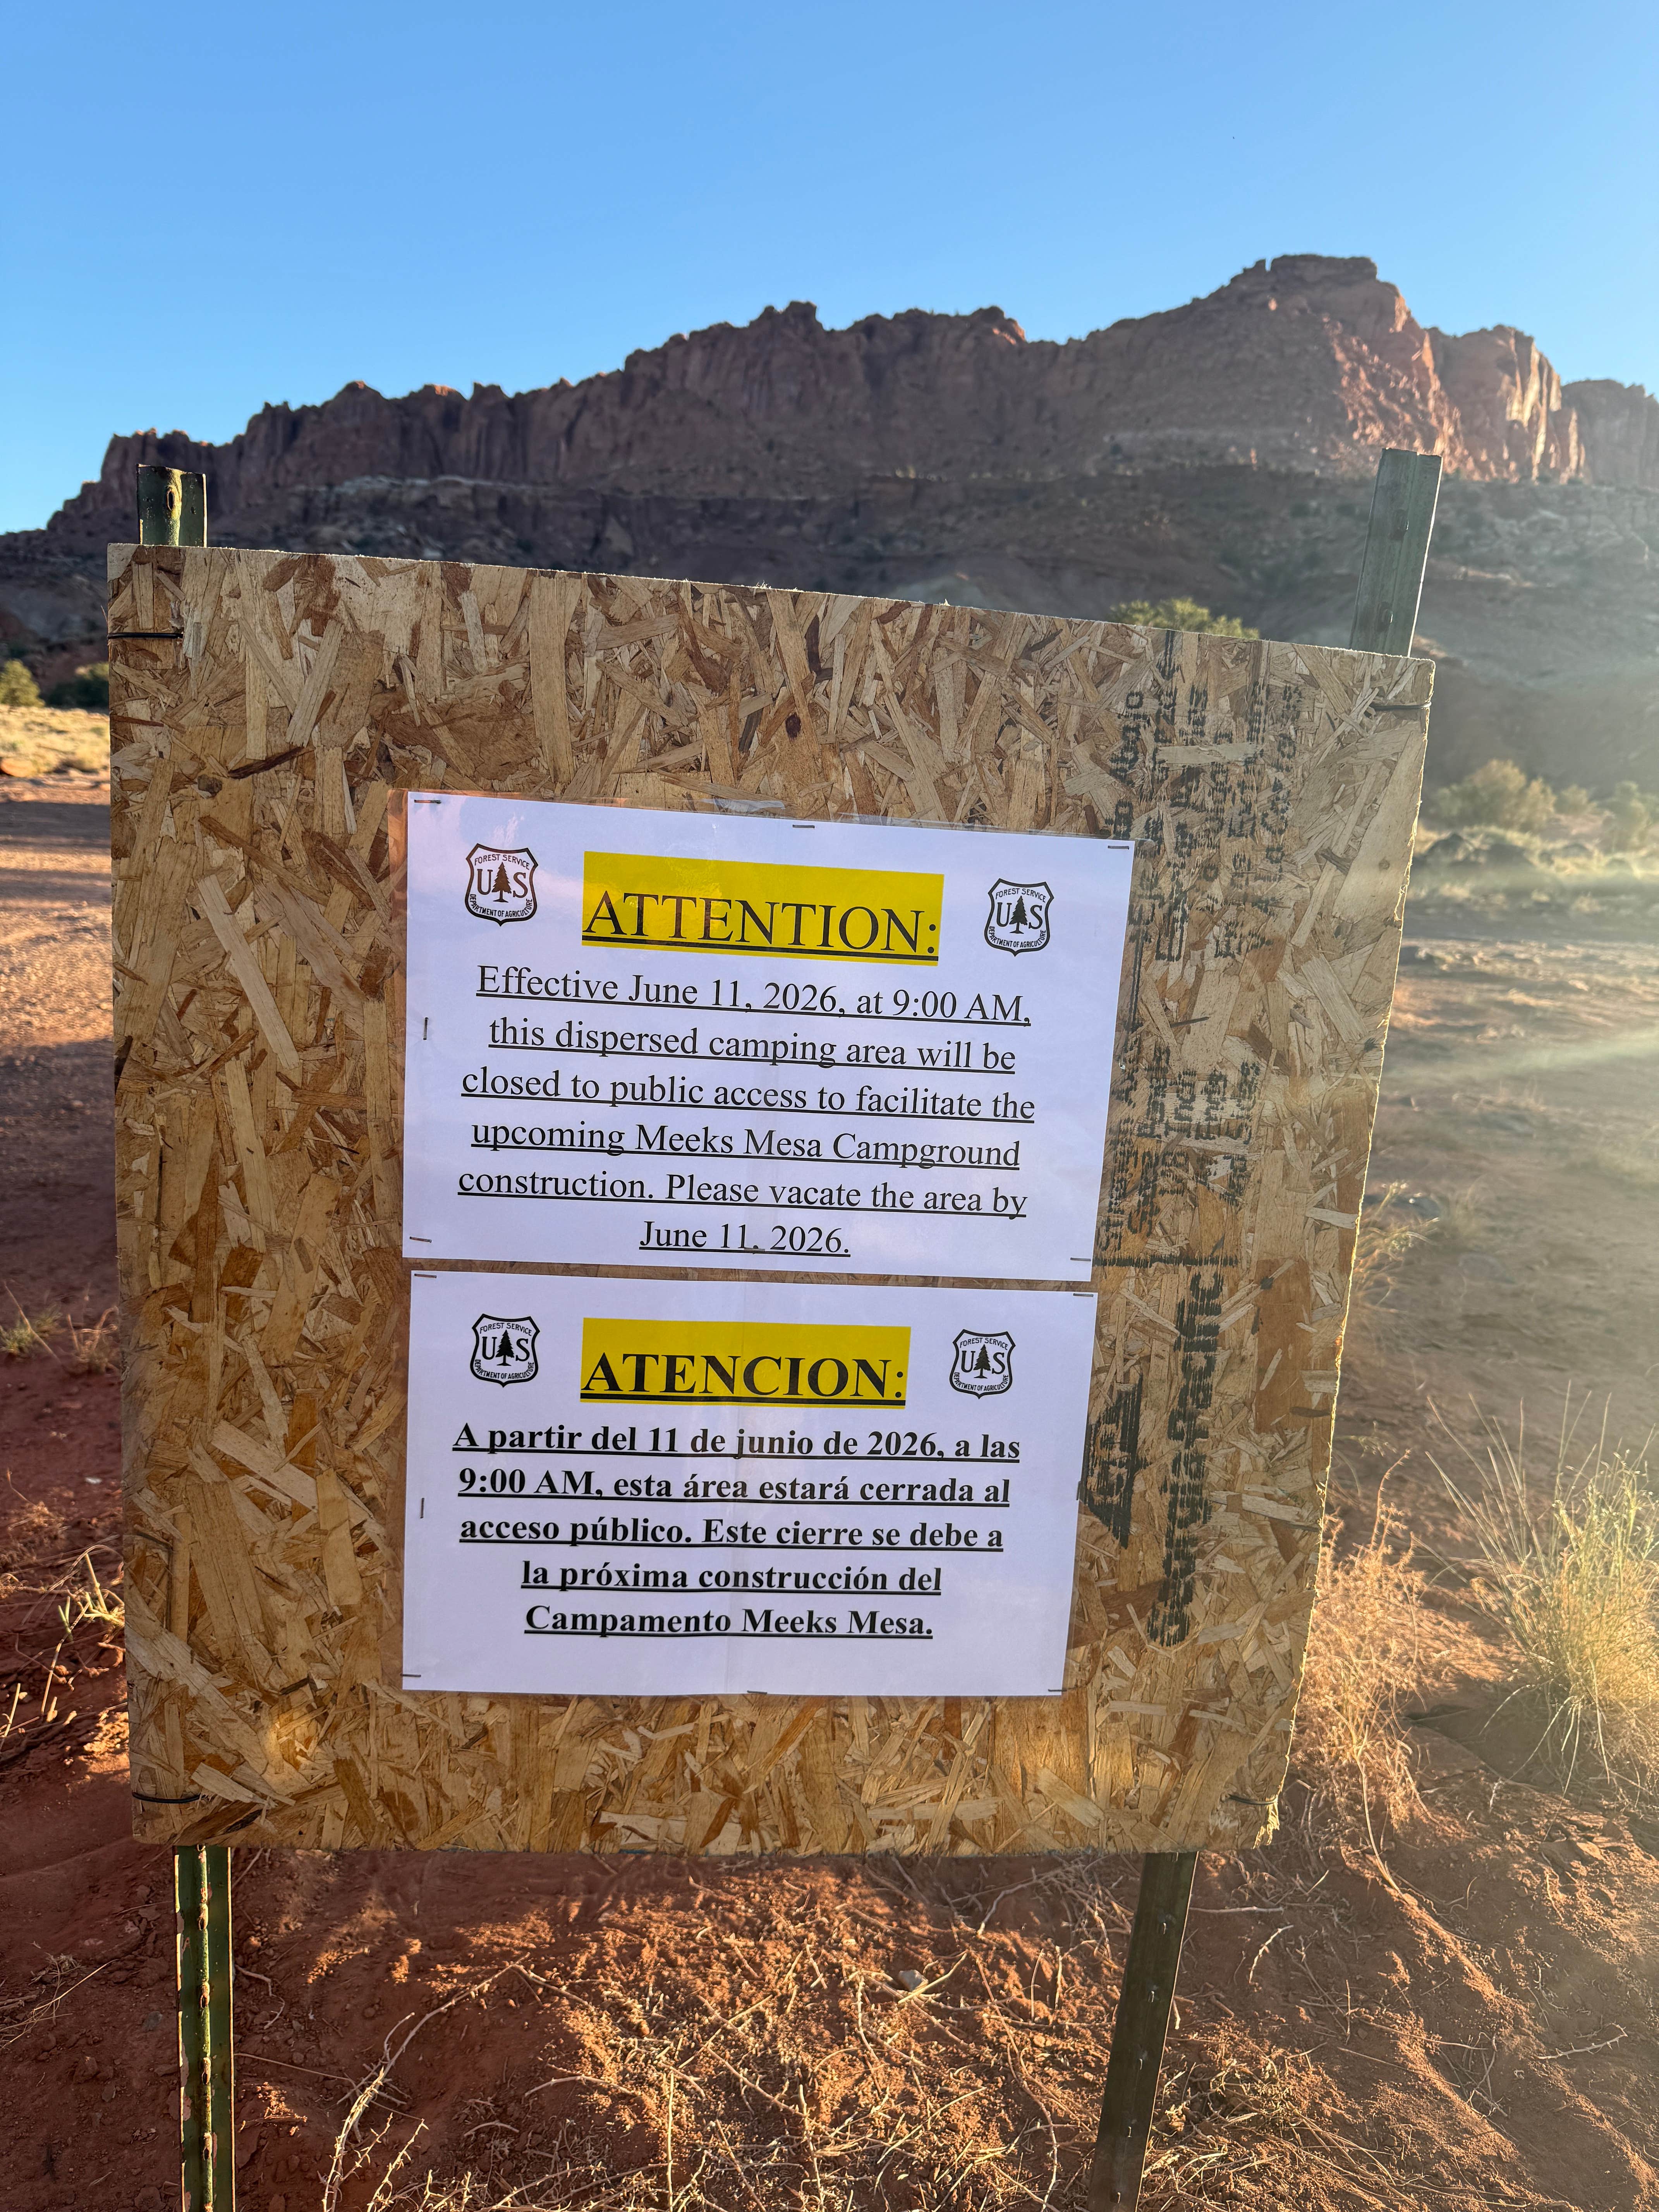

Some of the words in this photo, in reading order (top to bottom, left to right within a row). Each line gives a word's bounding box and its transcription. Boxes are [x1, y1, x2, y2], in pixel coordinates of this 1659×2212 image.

[474, 854, 500, 866] FOREST
[502, 855, 529, 870] SERVICE
[470, 894, 497, 916] DEPARTMENT
[505, 898, 532, 917] AGRICULTURE
[996, 888, 1020, 899] FOREST
[1022, 888, 1046, 902] SERVICE
[582, 891, 936, 953] ATTENTION:
[989, 926, 1013, 947] DEPARTMENT
[1020, 930, 1046, 948] AGRICULTURE
[477, 965, 618, 1000] Effective
[629, 975, 697, 1004] June
[712, 980, 751, 1012] 11,
[763, 983, 845, 1017] 2026,
[857, 992, 883, 1014] at
[893, 990, 957, 1018] 9:00
[964, 993, 1030, 1026] AM,
[489, 1017, 544, 1046] this
[556, 1021, 698, 1057] dispersed
[709, 1033, 836, 1068] camping
[847, 1045, 906, 1064] area
[917, 1041, 970, 1067] will
[984, 1042, 1015, 1070] be
[463, 1066, 560, 1096] closed
[571, 1075, 599, 1098] to
[610, 1075, 703, 1107] public
[714, 1087, 806, 1108] access
[818, 1087, 844, 1110] to
[855, 1085, 981, 1116] facilitate
[993, 1092, 1034, 1119] the
[472, 1121, 625, 1156] upcoming
[635, 1125, 733, 1153] Meeks
[744, 1129, 822, 1157] Mesa
[833, 1133, 1019, 1169] Campground
[459, 1171, 653, 1198] construction.
[665, 1175, 758, 1202] Please
[769, 1184, 860, 1206] vacate
[872, 1182, 914, 1208] the
[924, 1192, 982, 1211] area
[993, 1187, 1027, 1219] by
[640, 1221, 706, 1247] June
[721, 1224, 759, 1254] 11,
[771, 1225, 848, 1253] 2026.
[480, 1322, 504, 1334] FOREST
[506, 1323, 532, 1336] SERVICE
[960, 1338, 983, 1348] FOREST
[984, 1338, 1008, 1350] SERVICE
[475, 1360, 500, 1379] DEPARTMENT
[508, 1362, 534, 1379] AGRICULTURE
[580, 1352, 903, 1398] ATENCION:
[954, 1372, 976, 1391] DEPARTMENT
[984, 1374, 1008, 1391] AGRICULTURE
[453, 1423, 479, 1446] A
[488, 1425, 582, 1454] partir
[592, 1426, 636, 1450] del
[649, 1428, 677, 1452] 11
[691, 1429, 725, 1452] de
[733, 1429, 812, 1459] junio
[824, 1431, 857, 1455] de
[867, 1431, 944, 1460] 2026,
[955, 1441, 970, 1456] a
[981, 1434, 1019, 1458] las
[459, 1468, 525, 1493] 9:00
[534, 1470, 603, 1499] AM,
[614, 1475, 672, 1497] esta
[684, 1474, 748, 1498] área
[760, 1476, 849, 1499] estará
[860, 1478, 973, 1501] cerrada
[985, 1479, 1009, 1502] al
[461, 1521, 559, 1539] acceso
[571, 1516, 691, 1546] público.
[702, 1519, 766, 1543] Este
[777, 1521, 862, 1545] cierre
[872, 1529, 900, 1545] se
[910, 1523, 977, 1546] debe
[988, 1530, 1002, 1547] a
[522, 1561, 549, 1584] la
[560, 1562, 687, 1591] próxima
[699, 1566, 887, 1589] construcción
[899, 1568, 941, 1590] del
[526, 1606, 730, 1637] Campamento
[742, 1609, 836, 1633] Meeks
[848, 1611, 932, 1634] Mesa.
